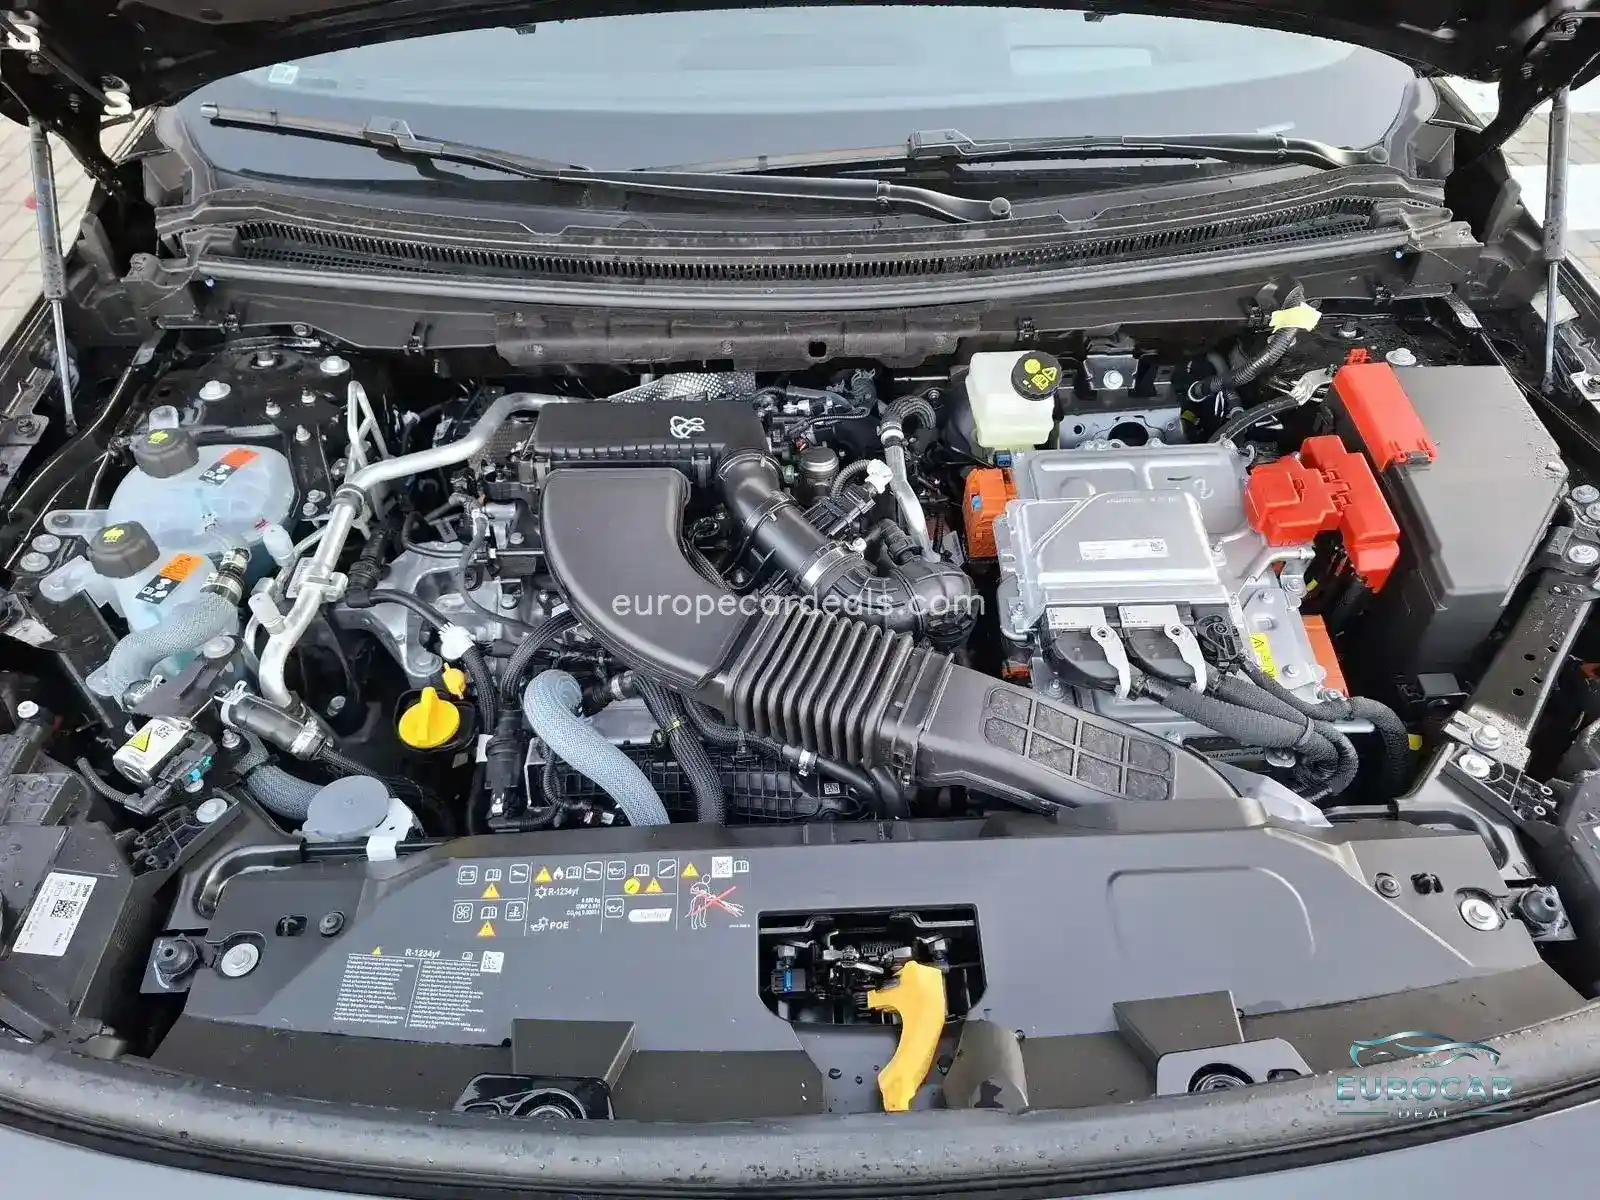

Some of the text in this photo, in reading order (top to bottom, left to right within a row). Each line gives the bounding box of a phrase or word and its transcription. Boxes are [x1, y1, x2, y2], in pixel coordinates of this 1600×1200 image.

[547, 887, 580, 897] R-1234yf
[549, 921, 569, 930] POE
[404, 949, 441, 959] R-1234yf
